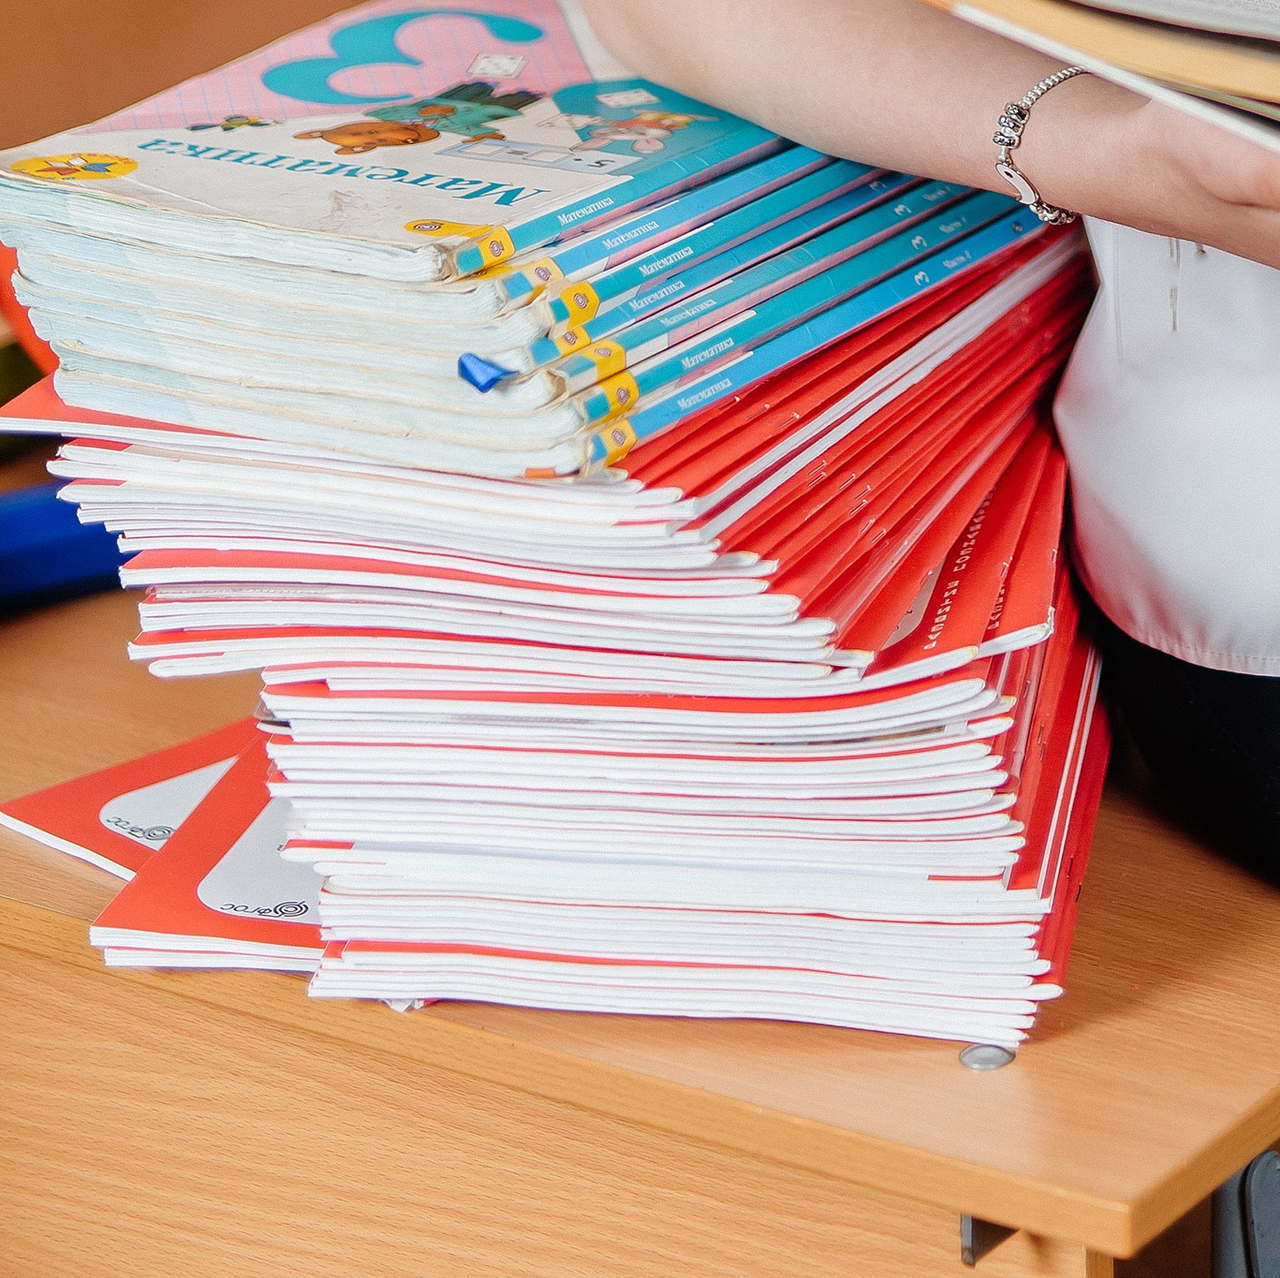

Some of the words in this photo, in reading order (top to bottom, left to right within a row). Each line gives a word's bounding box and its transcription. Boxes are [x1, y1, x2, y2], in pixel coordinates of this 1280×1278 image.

[262, 9, 544, 105] 3
[137, 139, 552, 206] Математика
[557, 196, 614, 225] Математика
[602, 220, 659, 250] Математика
[638, 245, 693, 276] Математика
[660, 299, 717, 326] Математика
[894, 204, 912, 216] 3
[628, 280, 685, 311] Математика
[681, 337, 735, 369] Математика
[911, 235, 928, 250] 3
[677, 378, 732, 411] Математика
[914, 271, 930, 286] 3
[220, 903, 273, 916] ФГОС
